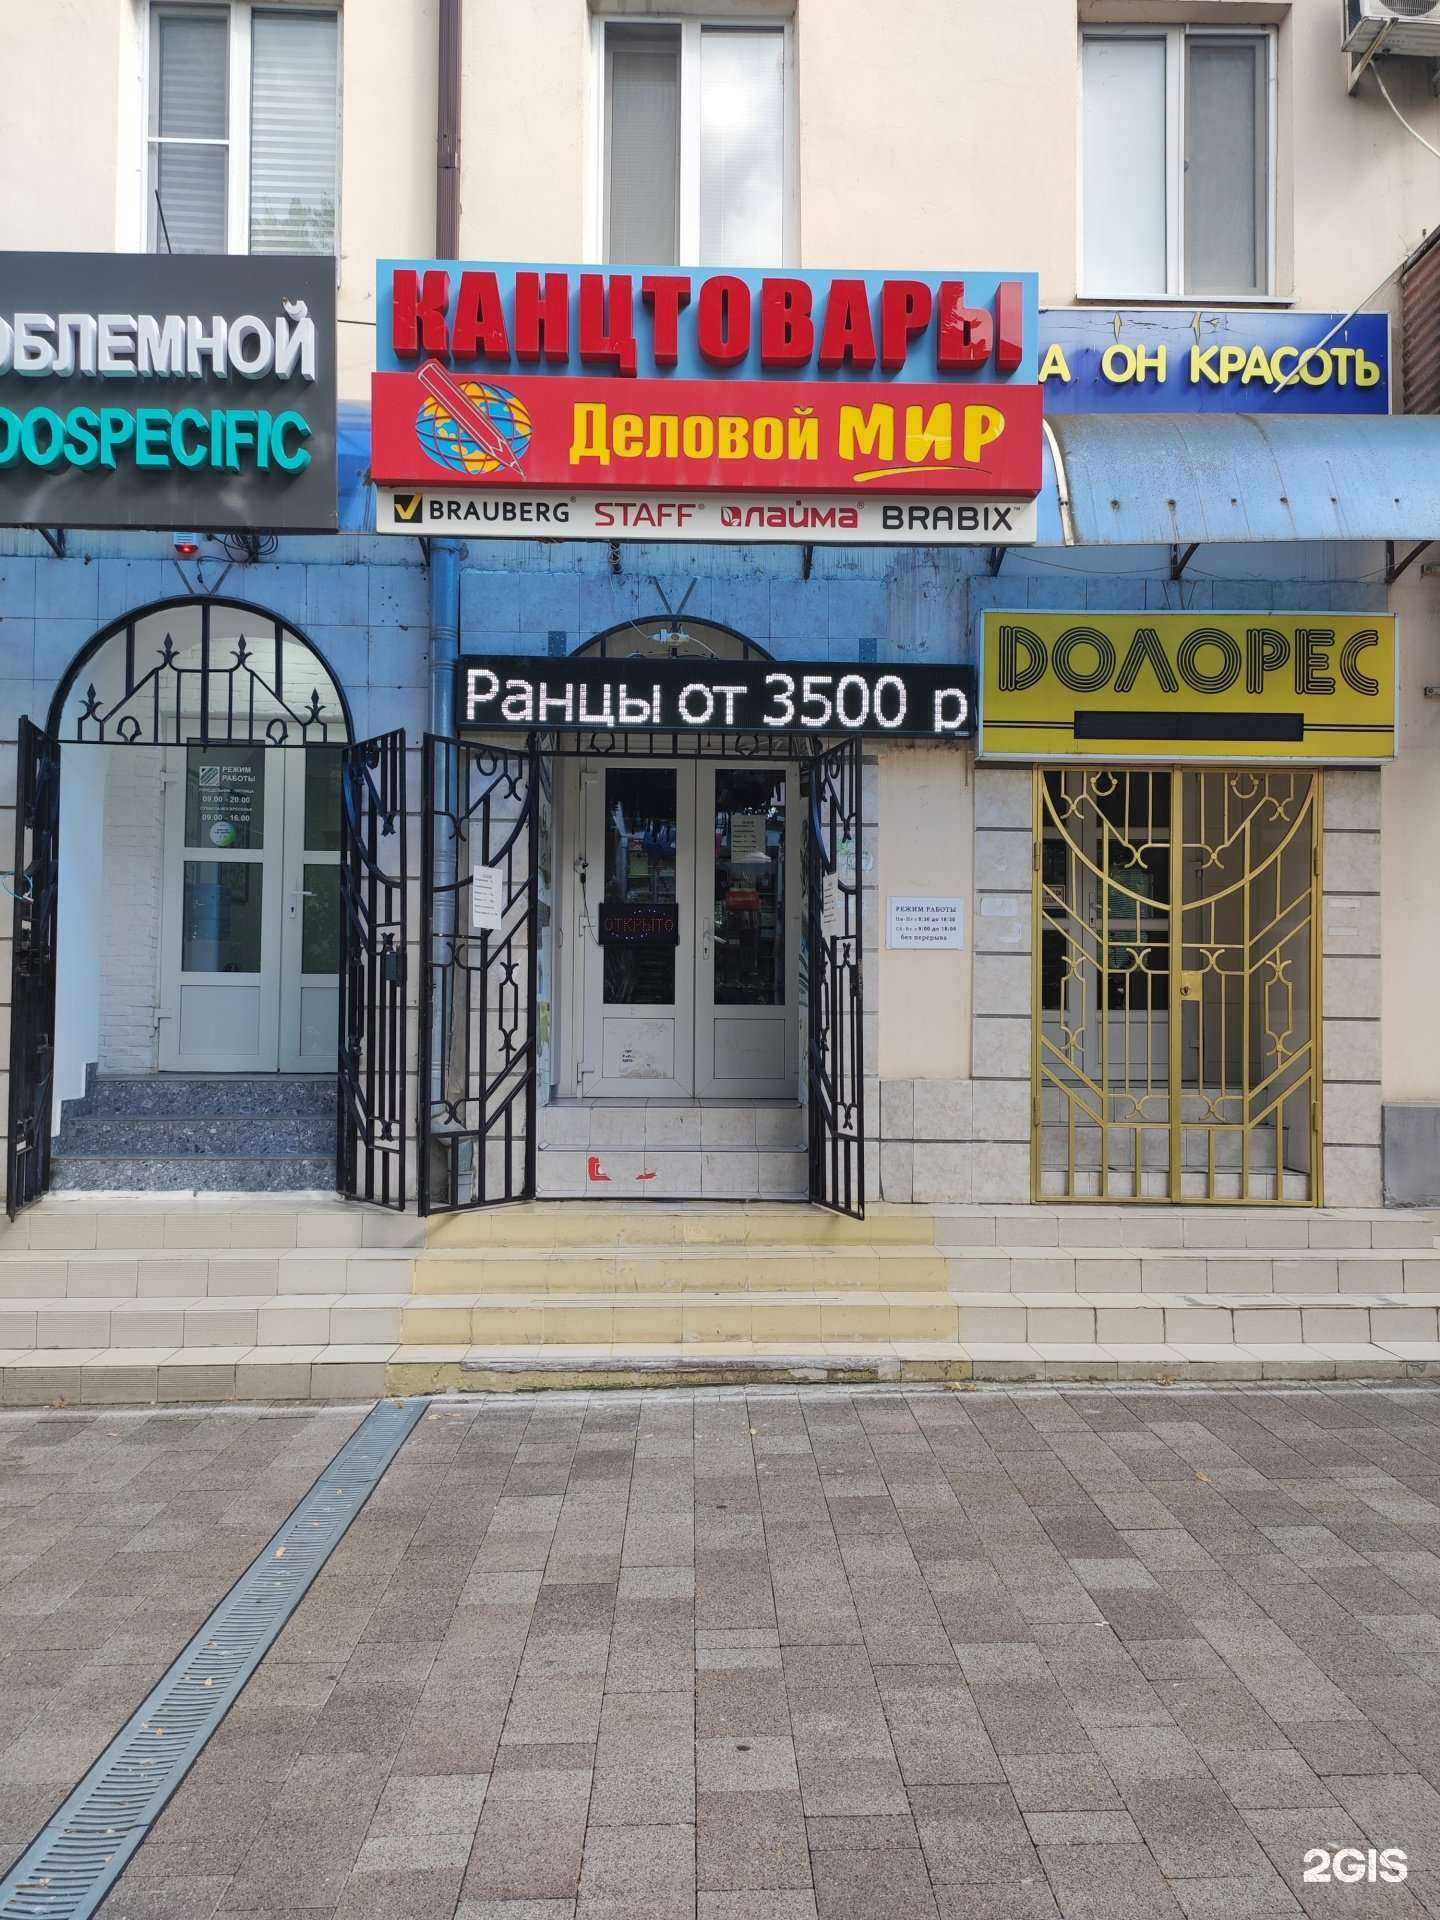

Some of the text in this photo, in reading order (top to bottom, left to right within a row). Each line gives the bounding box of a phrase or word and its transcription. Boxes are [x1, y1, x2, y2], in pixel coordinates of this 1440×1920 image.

[392, 268, 1024, 377] КАНЦТОВАРЫ
[569, 402, 1006, 466] Деловой МИР
[429, 500, 570, 523] BRAUBERG
[594, 502, 697, 528] STAFF
[881, 505, 1013, 531] BRABIX
[466, 668, 662, 727] Ранцы
[677, 683, 748, 725] от
[763, 673, 908, 728] 3500
